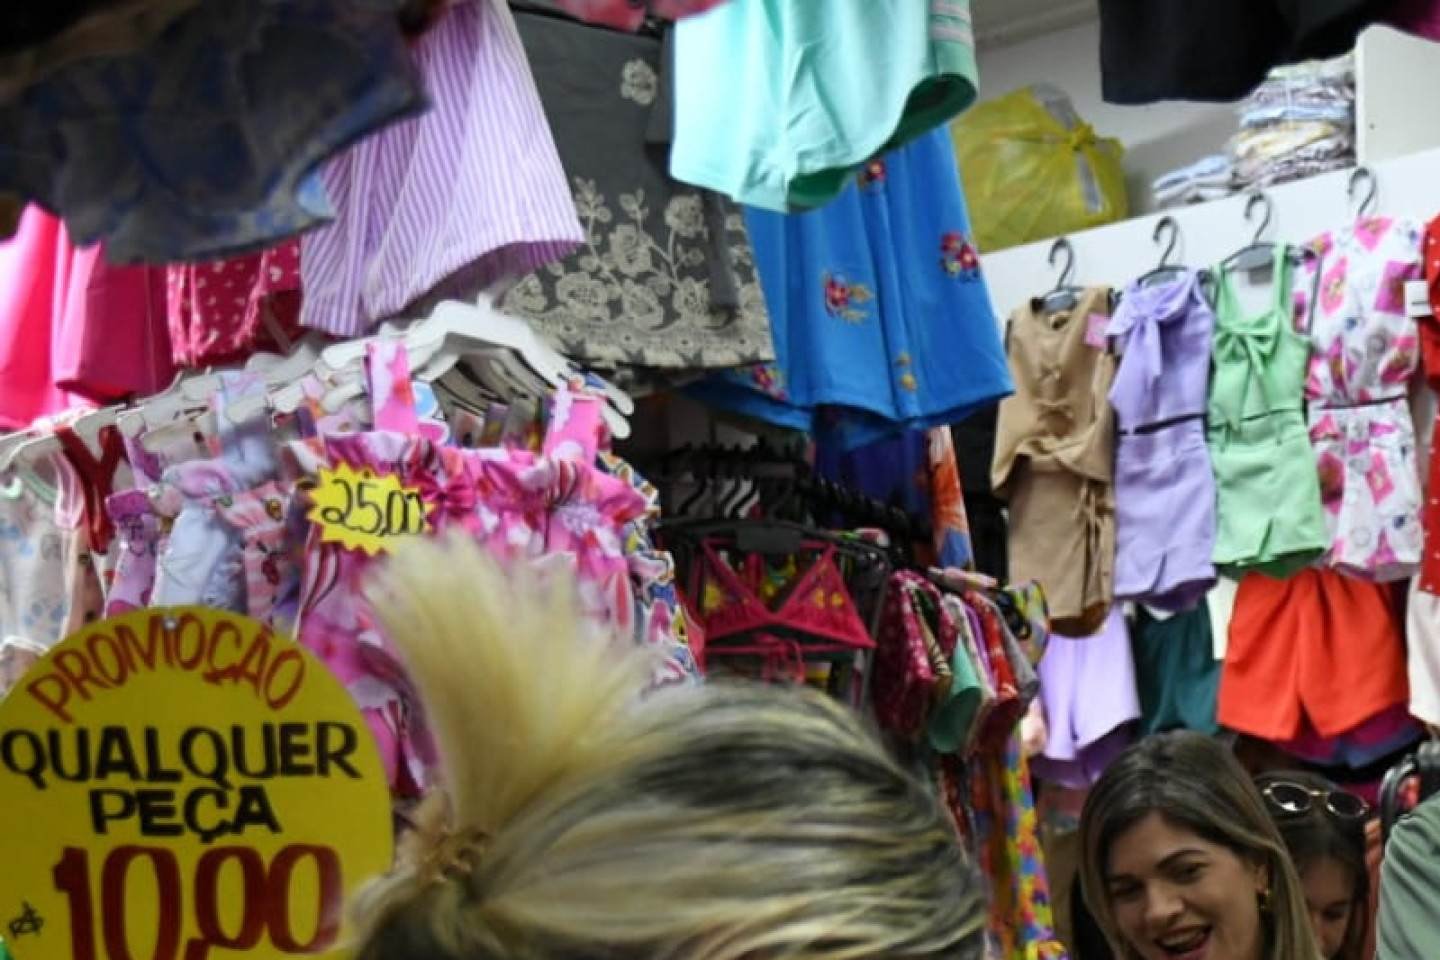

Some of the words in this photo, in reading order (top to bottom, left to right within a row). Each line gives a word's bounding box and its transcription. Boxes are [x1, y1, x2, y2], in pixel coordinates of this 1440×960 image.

[320, 478, 425, 537] 25,00
[1, 721, 362, 790] QUALQUER
[89, 785, 282, 843] PEÇA
